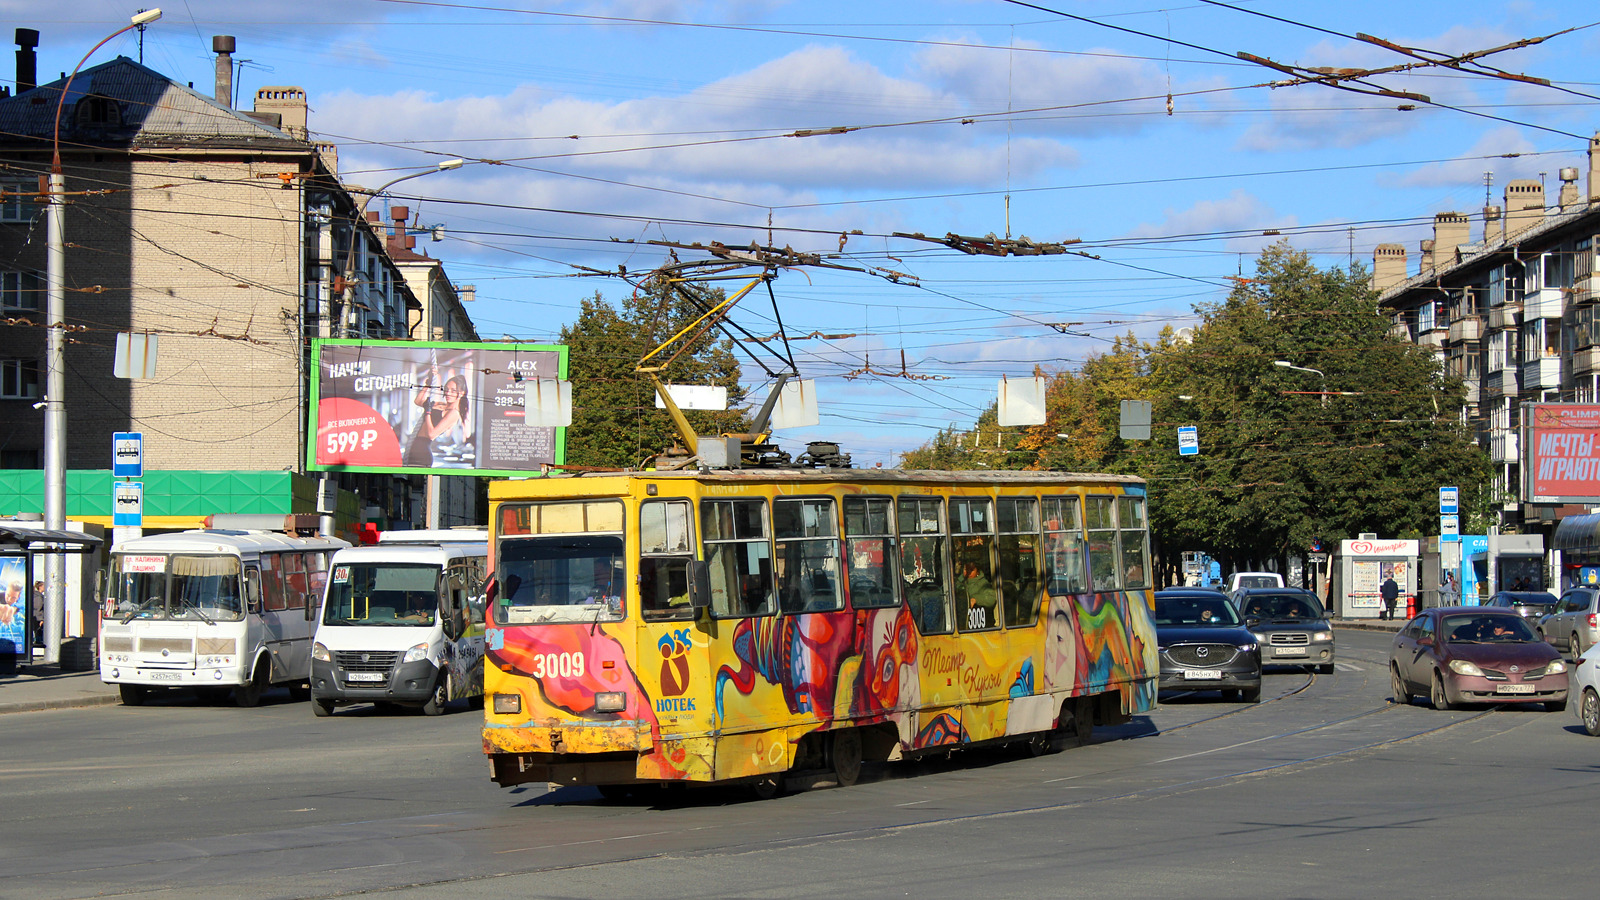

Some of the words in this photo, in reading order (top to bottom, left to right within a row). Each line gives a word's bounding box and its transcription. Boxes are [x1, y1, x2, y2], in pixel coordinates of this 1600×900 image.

[329, 360, 371, 379] НАЧНИ
[507, 360, 537, 370] ALEX
[327, 420, 337, 428] ВСЕ
[338, 418, 368, 427] ВКЛЮЧЕНО
[368, 416, 376, 424] ЗА
[327, 430, 359, 454] 599
[1538, 433, 1595, 457] МЕЧТЫ
[967, 607, 986, 629] 3009
[532, 651, 585, 679] 3009
[655, 697, 697, 712] НОТЕК
